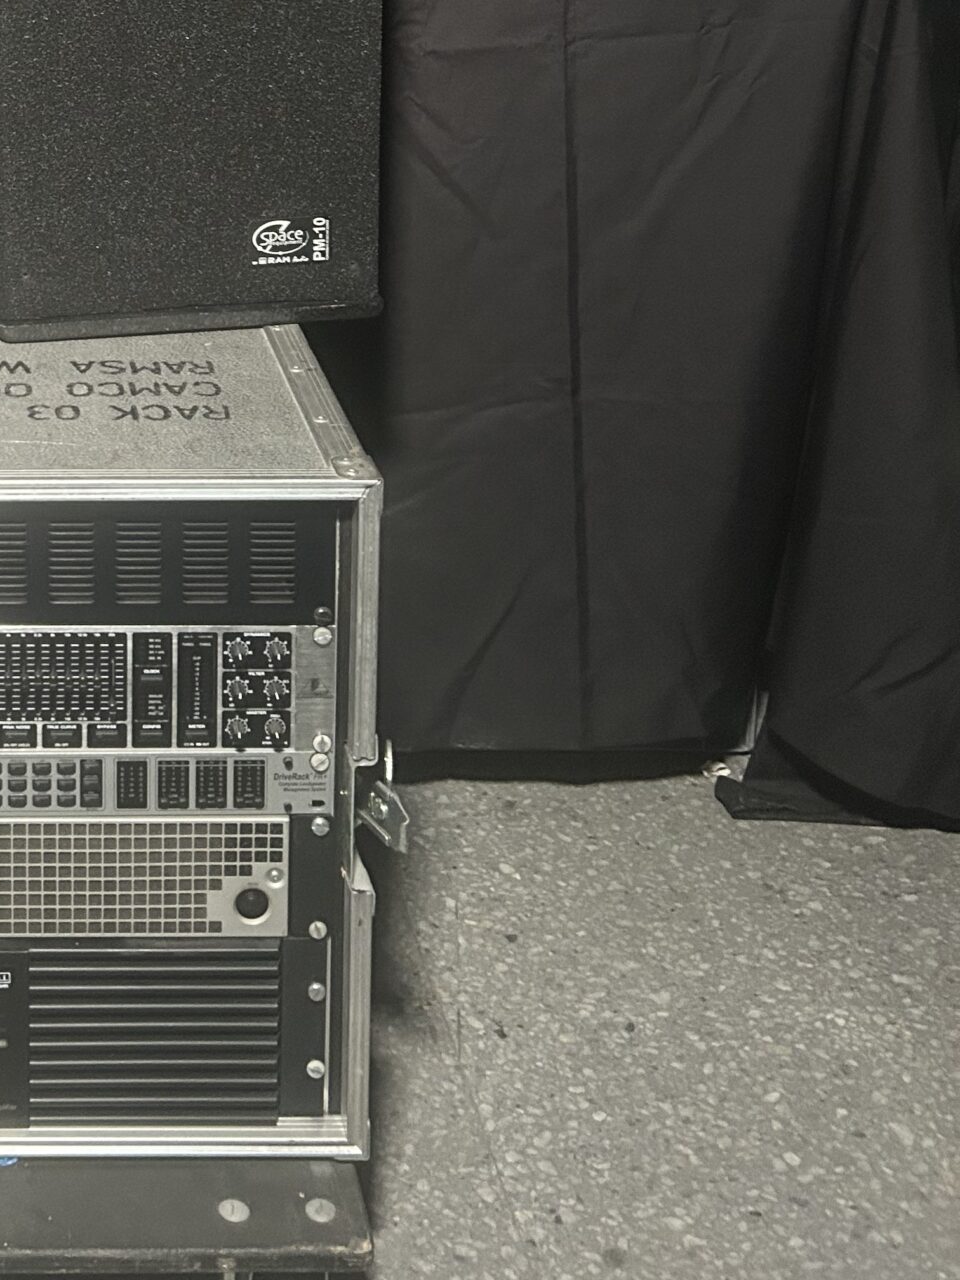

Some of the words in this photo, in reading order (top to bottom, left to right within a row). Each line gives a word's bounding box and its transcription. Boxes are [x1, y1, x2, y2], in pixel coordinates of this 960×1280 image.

[259, 229, 304, 246] Space
[312, 217, 326, 261] PM-10
[70, 359, 215, 375] RAMSA
[66, 381, 222, 397] CAMCO
[26, 403, 81, 421] 03
[108, 403, 231, 421] RACK
